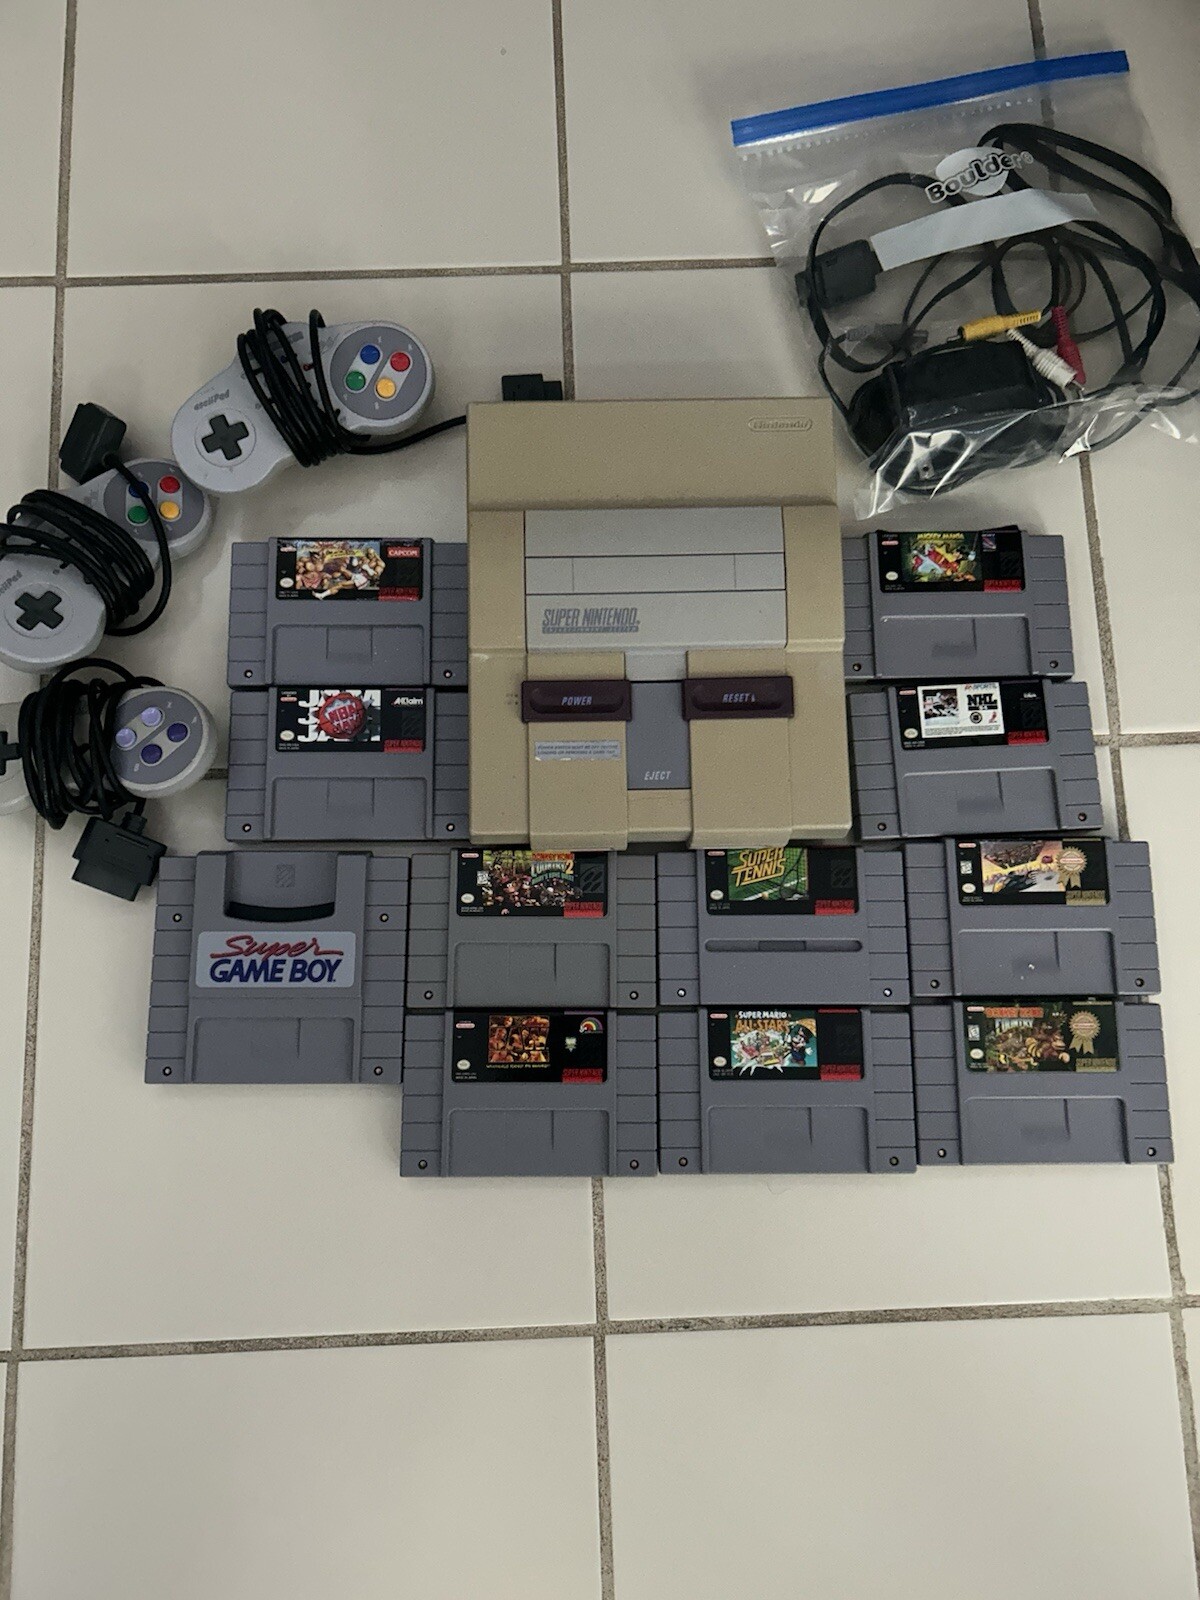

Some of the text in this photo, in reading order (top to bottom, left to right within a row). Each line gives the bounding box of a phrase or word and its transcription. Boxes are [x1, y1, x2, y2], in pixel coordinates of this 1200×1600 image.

[925, 152, 1022, 203] Boulder
[388, 549, 418, 557] CAPCOM
[542, 607, 638, 627] SUPER NINTENDO
[561, 696, 592, 706] POWER
[722, 692, 751, 703] RESET
[966, 693, 998, 706] NHL
[644, 770, 671, 781] EJECT
[733, 847, 784, 870] SUPER
[565, 860, 574, 875] 2
[731, 858, 787, 887] TENNIS
[210, 934, 344, 961] Super
[210, 958, 343, 983] GAME BOY
[738, 1010, 761, 1019] SUPER
[761, 1010, 788, 1019] MARIO
